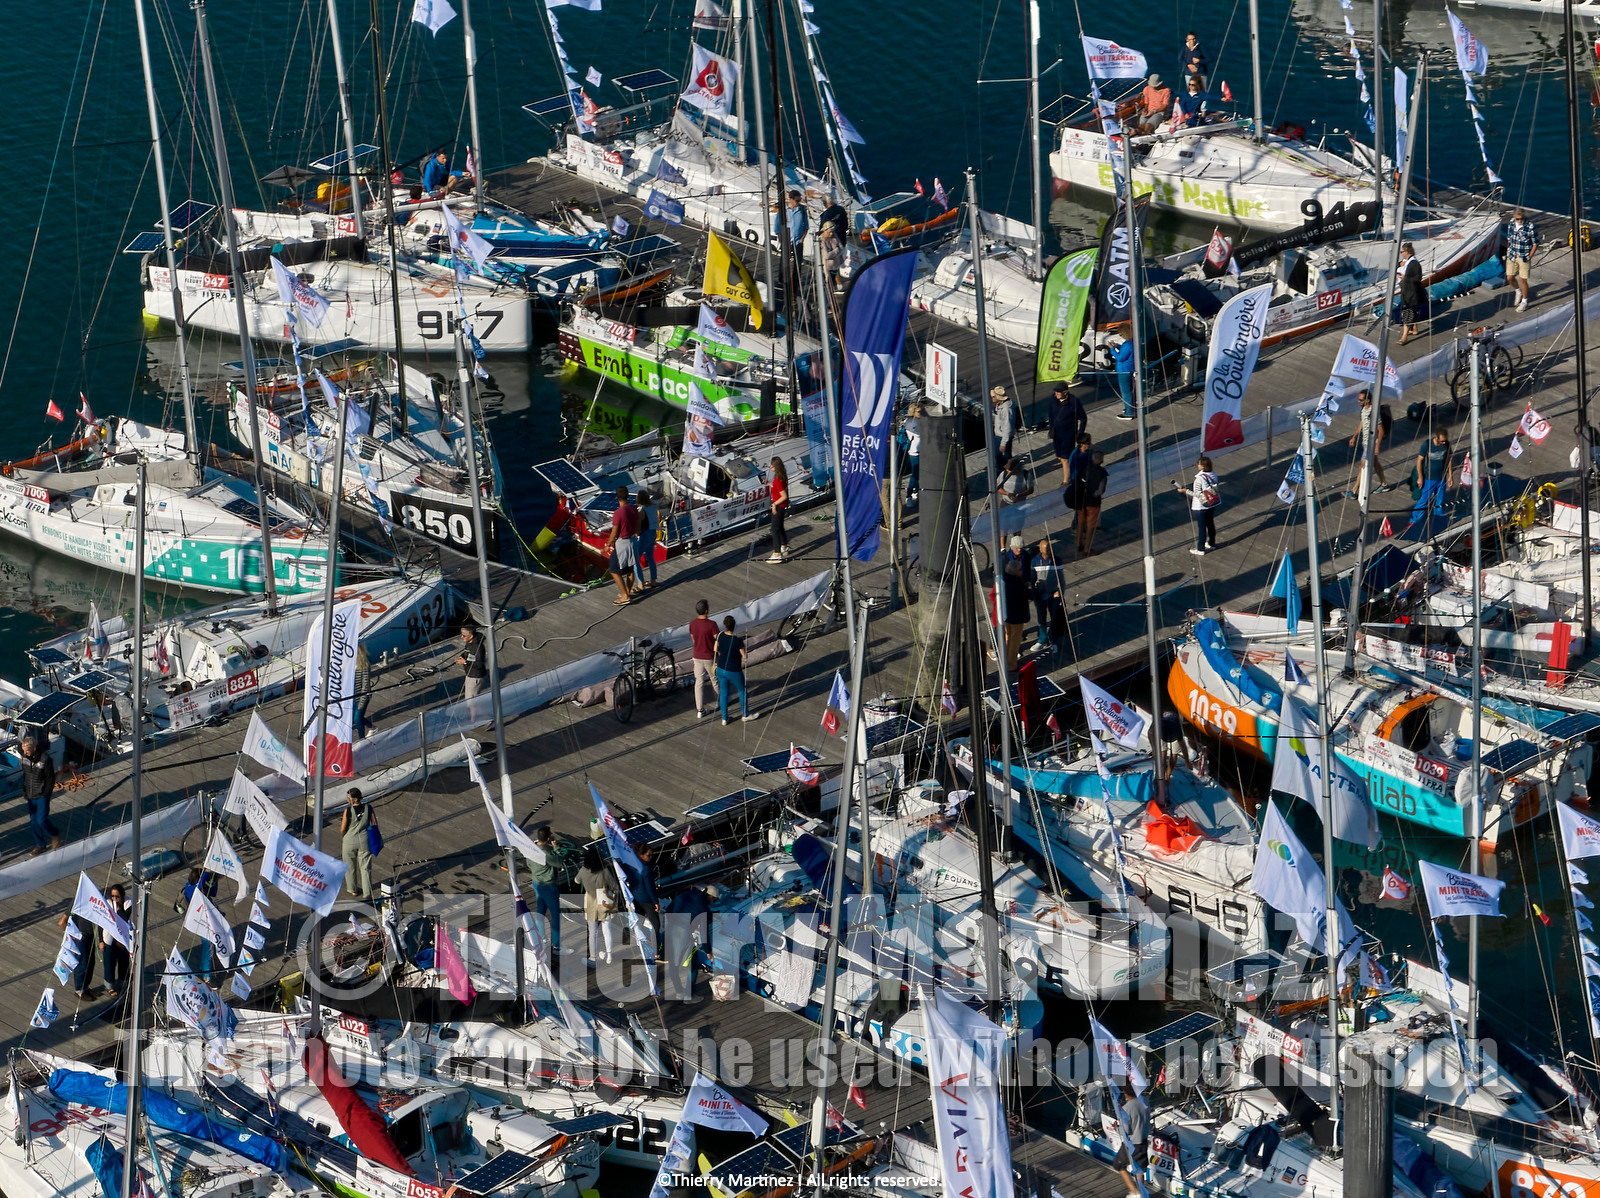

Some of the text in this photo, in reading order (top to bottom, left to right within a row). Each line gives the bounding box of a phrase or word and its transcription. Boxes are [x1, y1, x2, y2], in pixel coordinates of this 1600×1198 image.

[204, 276, 225, 288] 947
[726, 286, 738, 296] GUY
[1320, 292, 1340, 308] 527
[610, 322, 634, 339] 1002
[1212, 297, 1260, 400] Boulangère
[1214, 363, 1230, 376] la
[1350, 358, 1370, 367] MINI
[26, 486, 47, 500] 1009
[32, 504, 46, 514] FRA
[401, 504, 473, 545] 850
[406, 594, 445, 646] 882
[230, 674, 253, 692] 882
[1188, 688, 1238, 740] 1039
[1417, 758, 1444, 778] 1039
[1426, 780, 1444, 793] FRA
[284, 850, 325, 880] Boulangère
[274, 858, 328, 892] MINI TRANSAT
[944, 873, 978, 888] EQUANS
[1438, 886, 1460, 896] MINI
[1126, 960, 1164, 980] EQUANS
[340, 1018, 366, 1034] 1022
[354, 1037, 369, 1050] FRA
[1284, 1036, 1302, 1054] 879
[698, 1098, 720, 1110] MINI
[1154, 1138, 1174, 1152] 921
[1159, 1160, 1176, 1172] BEL
[410, 1183, 440, 1198] 1053
